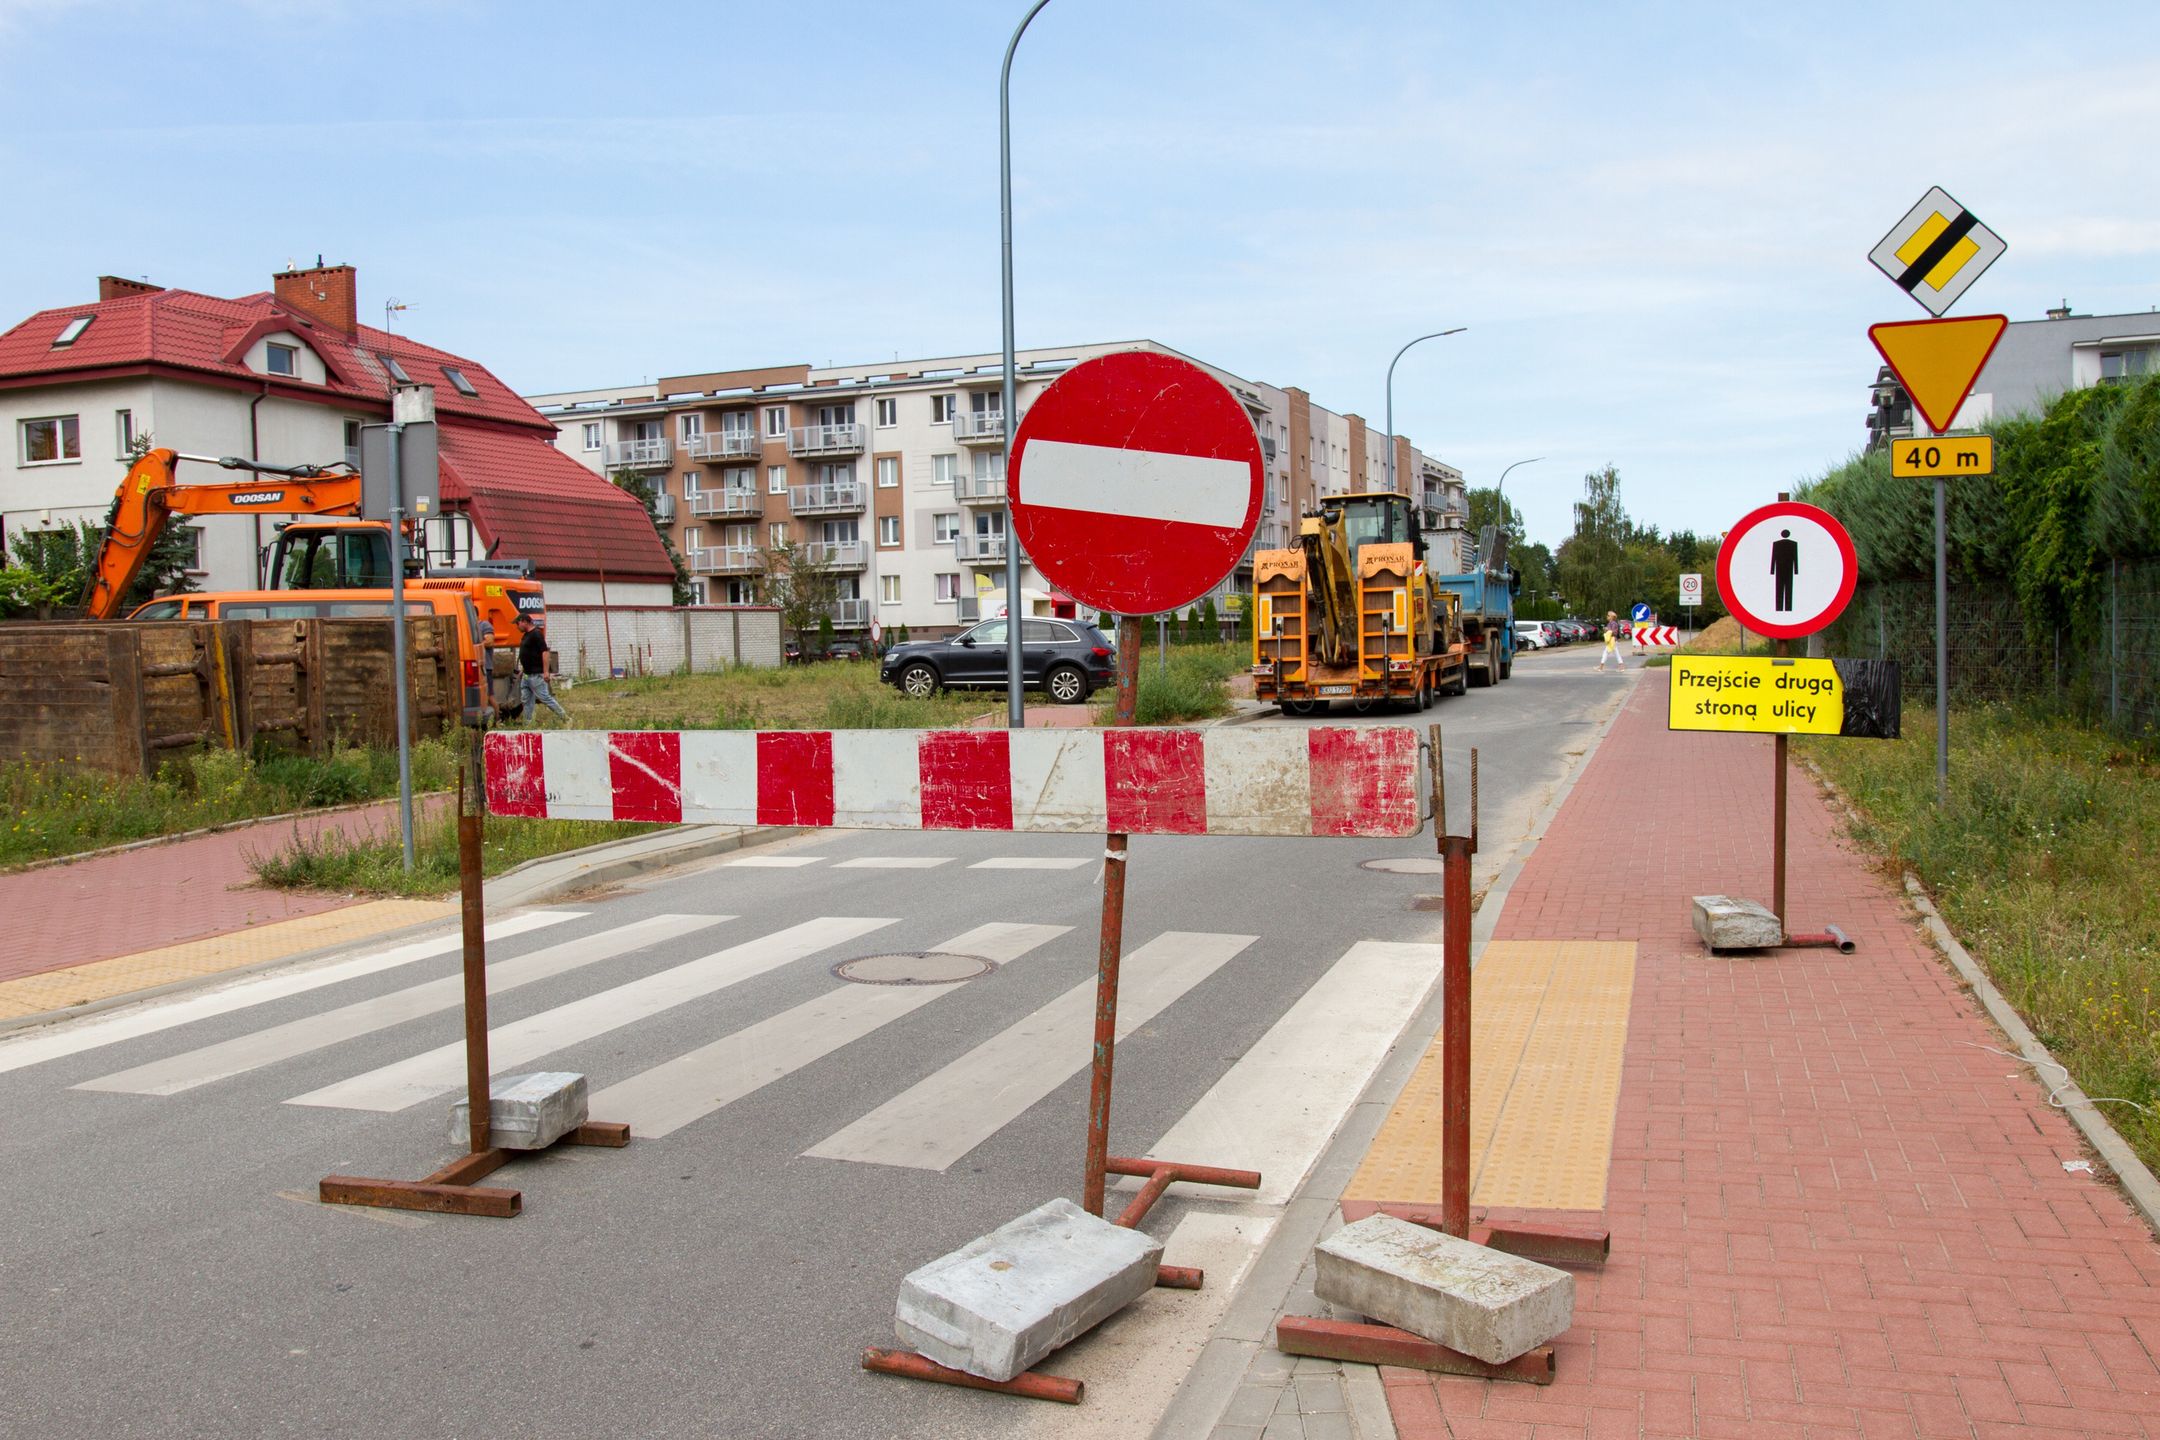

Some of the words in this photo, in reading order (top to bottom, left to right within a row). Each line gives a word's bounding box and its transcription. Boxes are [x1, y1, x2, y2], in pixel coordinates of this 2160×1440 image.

[1905, 447, 1940, 468] 40
[1957, 452, 1978, 467] m
[234, 493, 281, 503] DOOSAN
[1679, 669, 1761, 692] Przejście
[1775, 672, 1834, 695] drugą
[1695, 699, 1757, 721] stroną
[1772, 700, 1816, 723] ulicy
